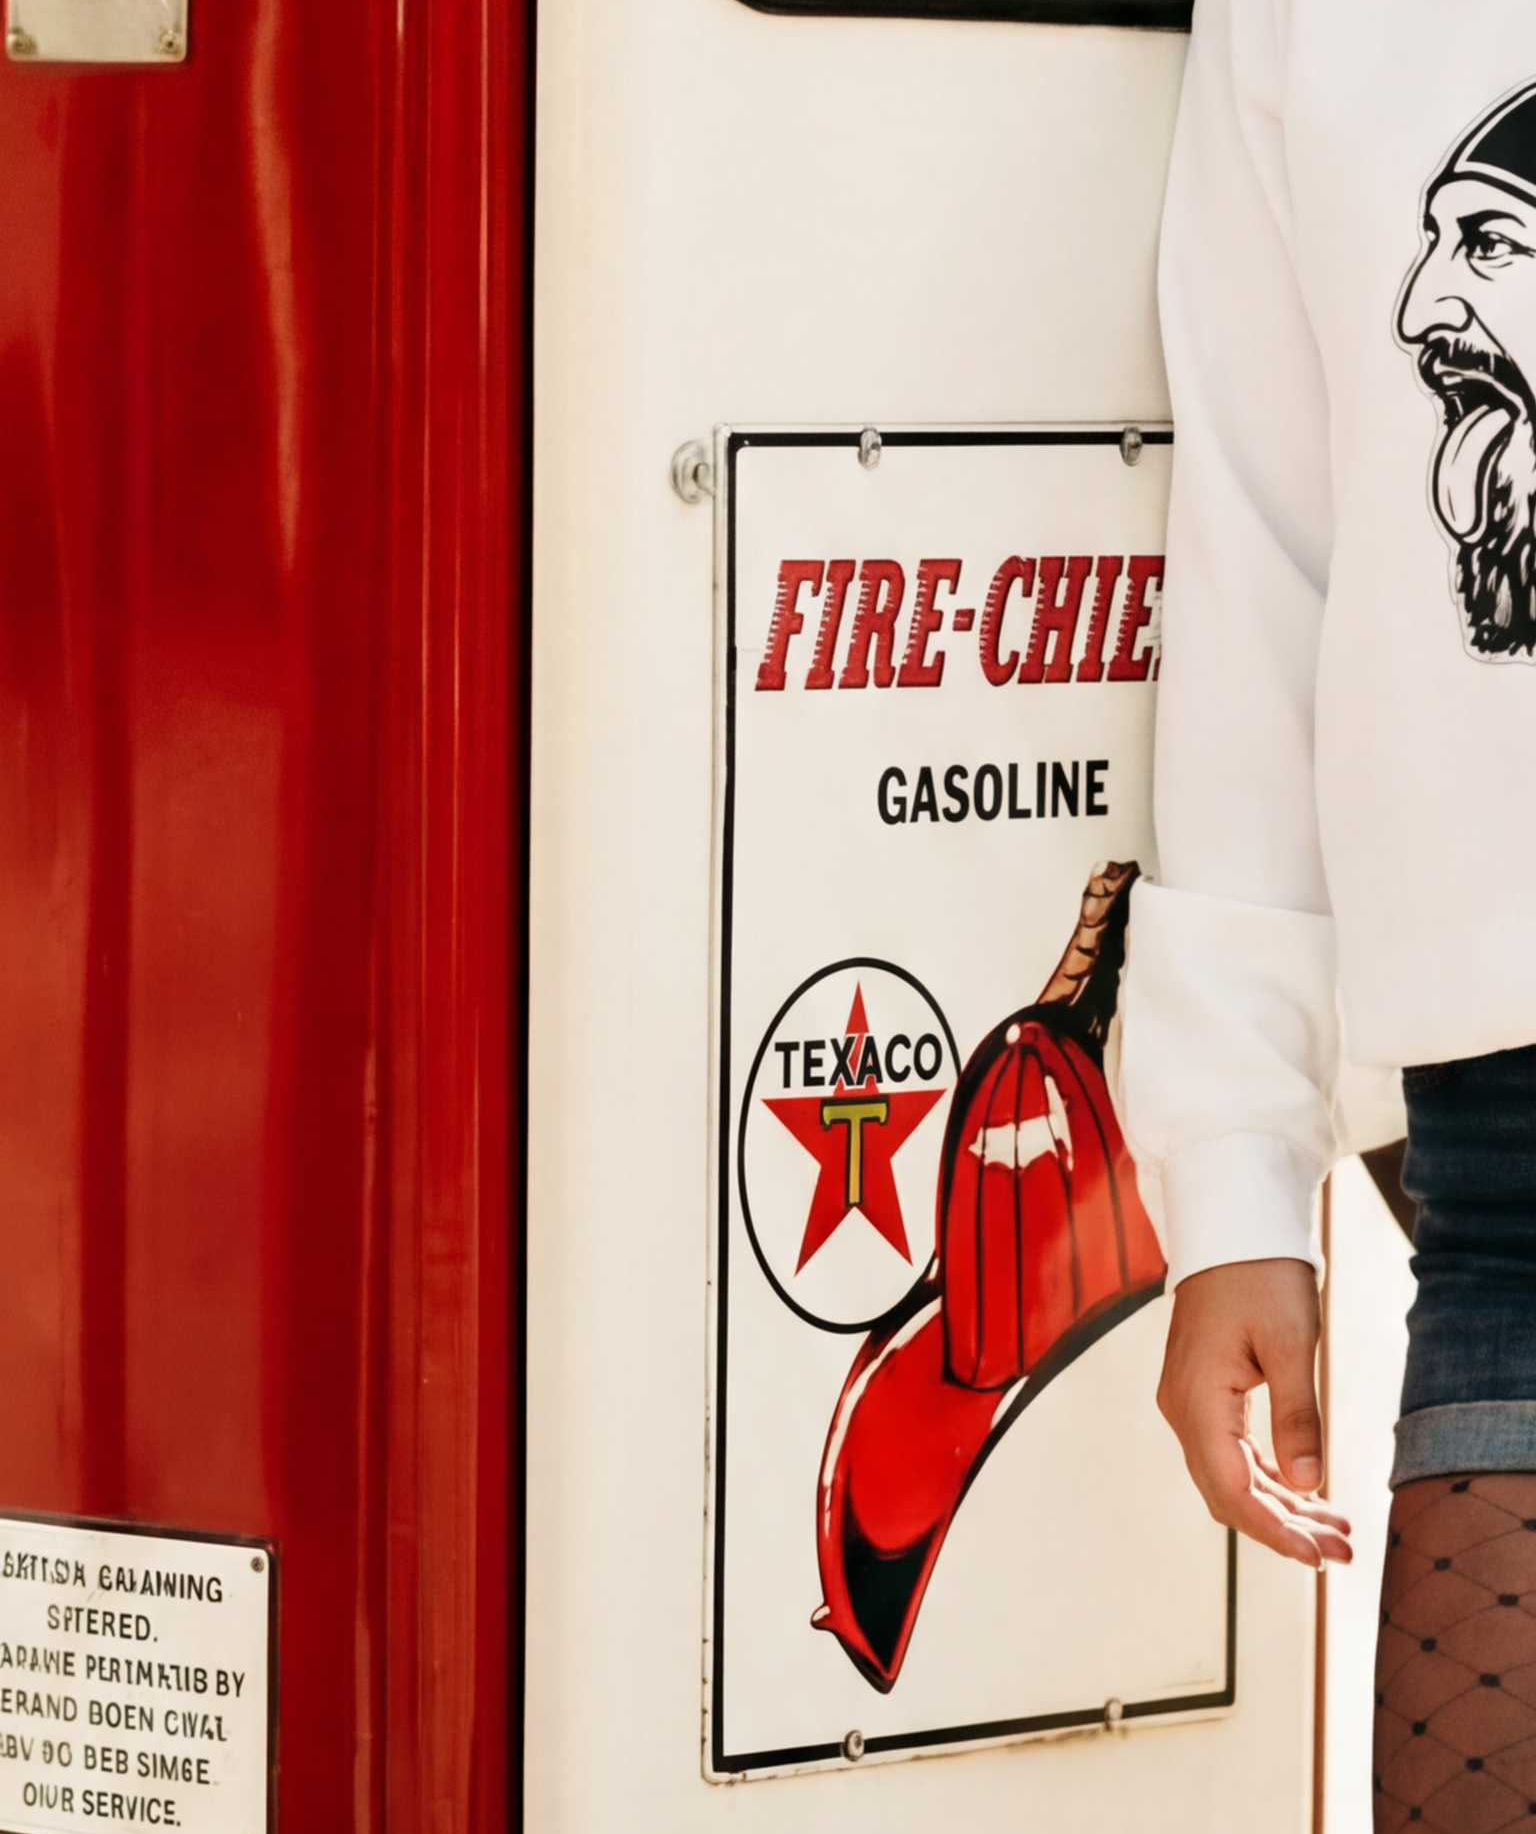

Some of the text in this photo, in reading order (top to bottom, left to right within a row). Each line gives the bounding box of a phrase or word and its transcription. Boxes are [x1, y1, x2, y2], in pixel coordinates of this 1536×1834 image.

[754, 554, 1166, 692] FIRE-CHIE
[877, 760, 1110, 825] GASOLINE
[774, 1033, 943, 1089] TEXACO
[820, 1095, 890, 1210] T
[216, 1669, 245, 1698] BY
[89, 1699, 154, 1733] BOEN
[84, 1743, 129, 1775] BEB
[82, 1788, 181, 1828] SERVICE.
